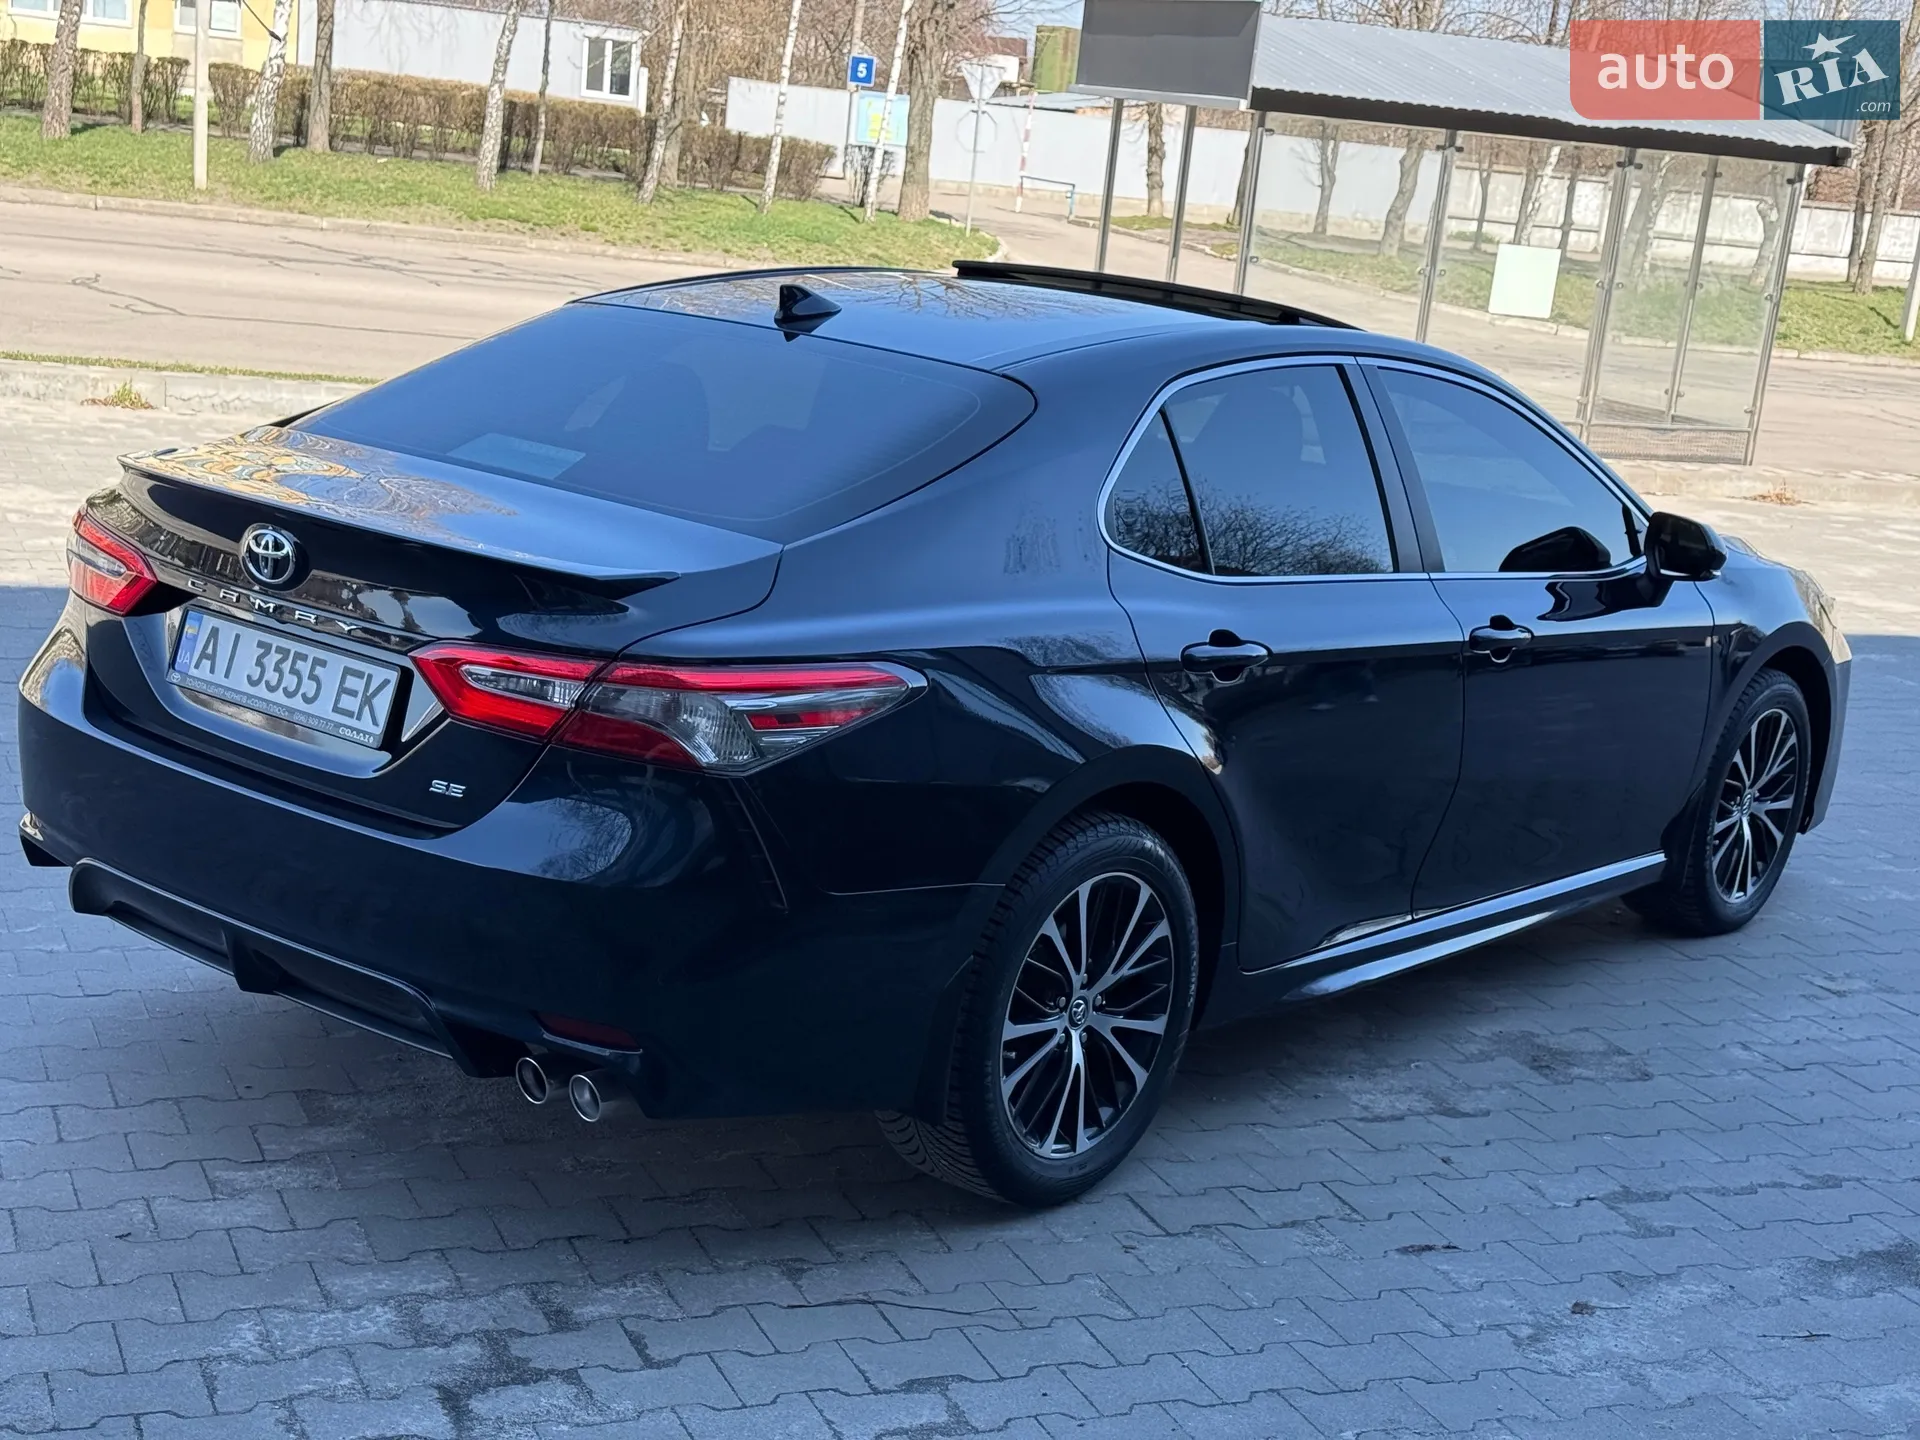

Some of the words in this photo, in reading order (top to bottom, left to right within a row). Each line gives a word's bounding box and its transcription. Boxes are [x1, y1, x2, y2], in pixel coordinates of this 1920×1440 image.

[856, 62, 868, 78] 5
[188, 577, 361, 635] CAMRY
[177, 651, 191, 665] UA
[194, 626, 241, 680] AI
[247, 639, 328, 705] 3355
[332, 665, 391, 728] EK
[429, 780, 466, 797] SE
